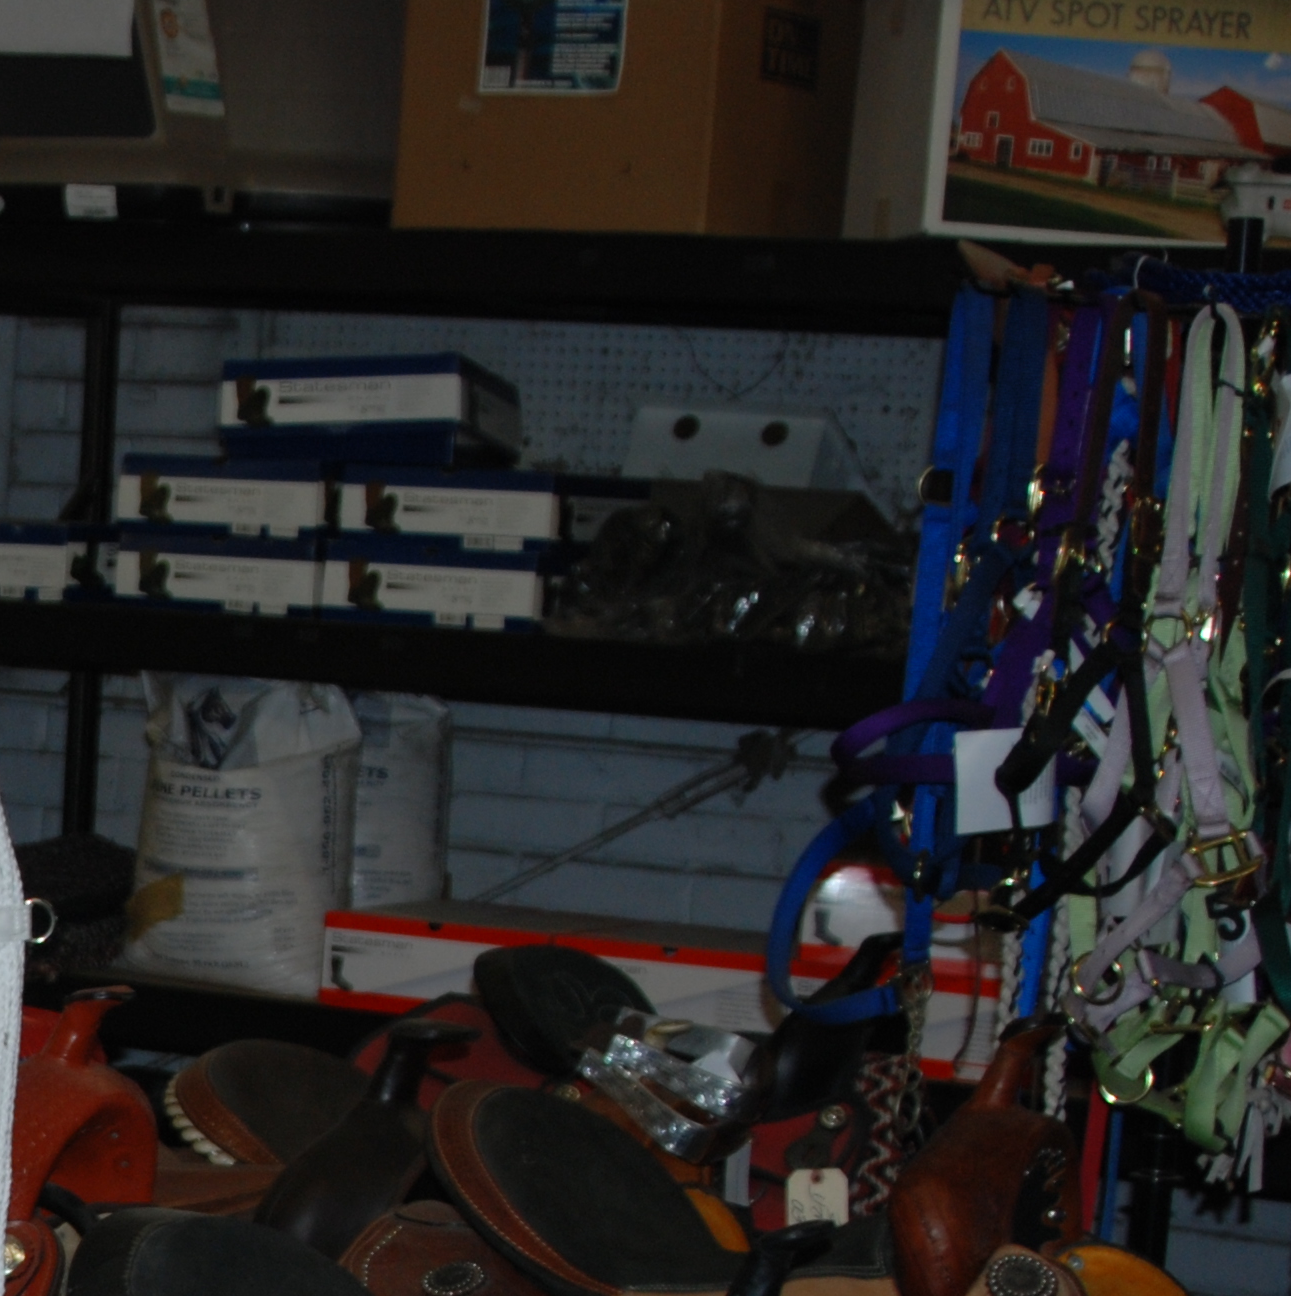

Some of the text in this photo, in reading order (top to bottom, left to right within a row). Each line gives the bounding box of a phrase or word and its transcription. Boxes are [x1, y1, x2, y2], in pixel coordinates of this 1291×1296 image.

[983, 0, 1254, 40] ATV SPOT SPRAYER
[180, 785, 262, 801] PELLETS
